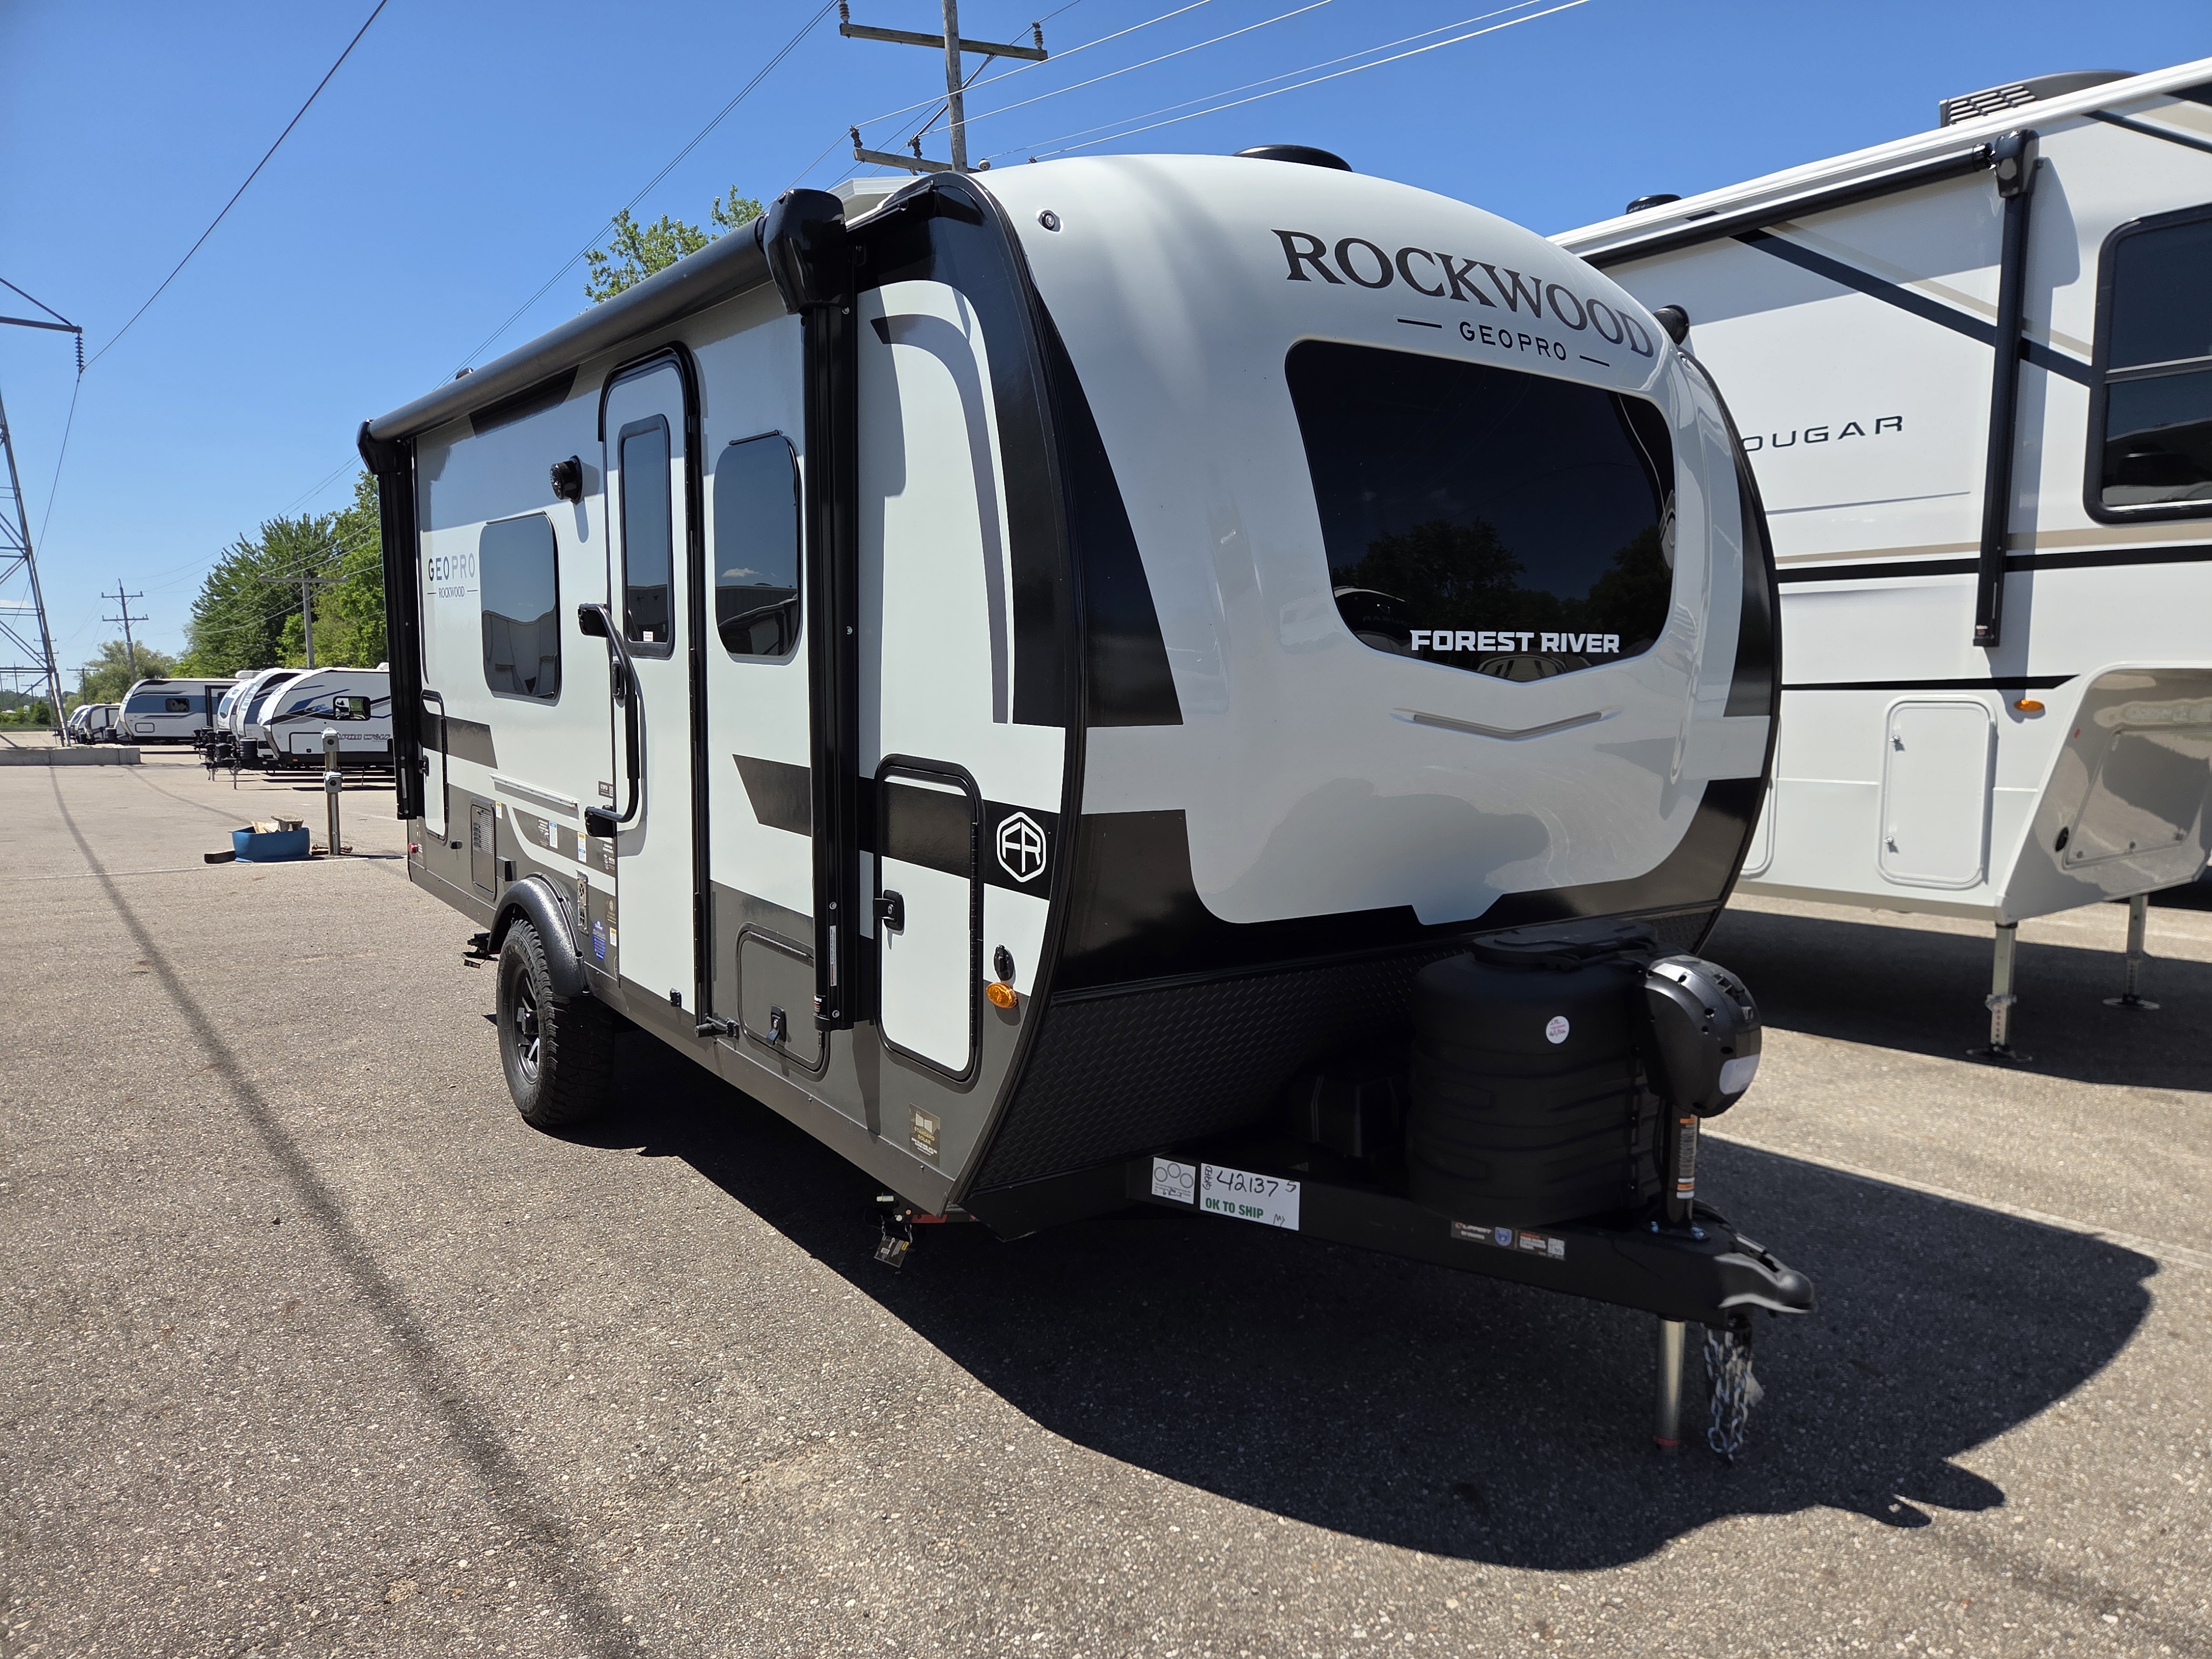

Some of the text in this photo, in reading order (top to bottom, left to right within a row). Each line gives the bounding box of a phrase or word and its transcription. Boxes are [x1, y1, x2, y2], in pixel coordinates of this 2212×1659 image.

[1270, 229, 1655, 358] ROCKWOOD
[1459, 321, 1567, 362] GEOPRO
[1741, 415, 1903, 452] OUGAR
[428, 552, 476, 582] GEOPRO
[438, 586, 465, 598] ROCKWOOD
[1410, 630, 1620, 653] FOREST RIVER
[1205, 1197, 1264, 1219] OK TO SHIP
